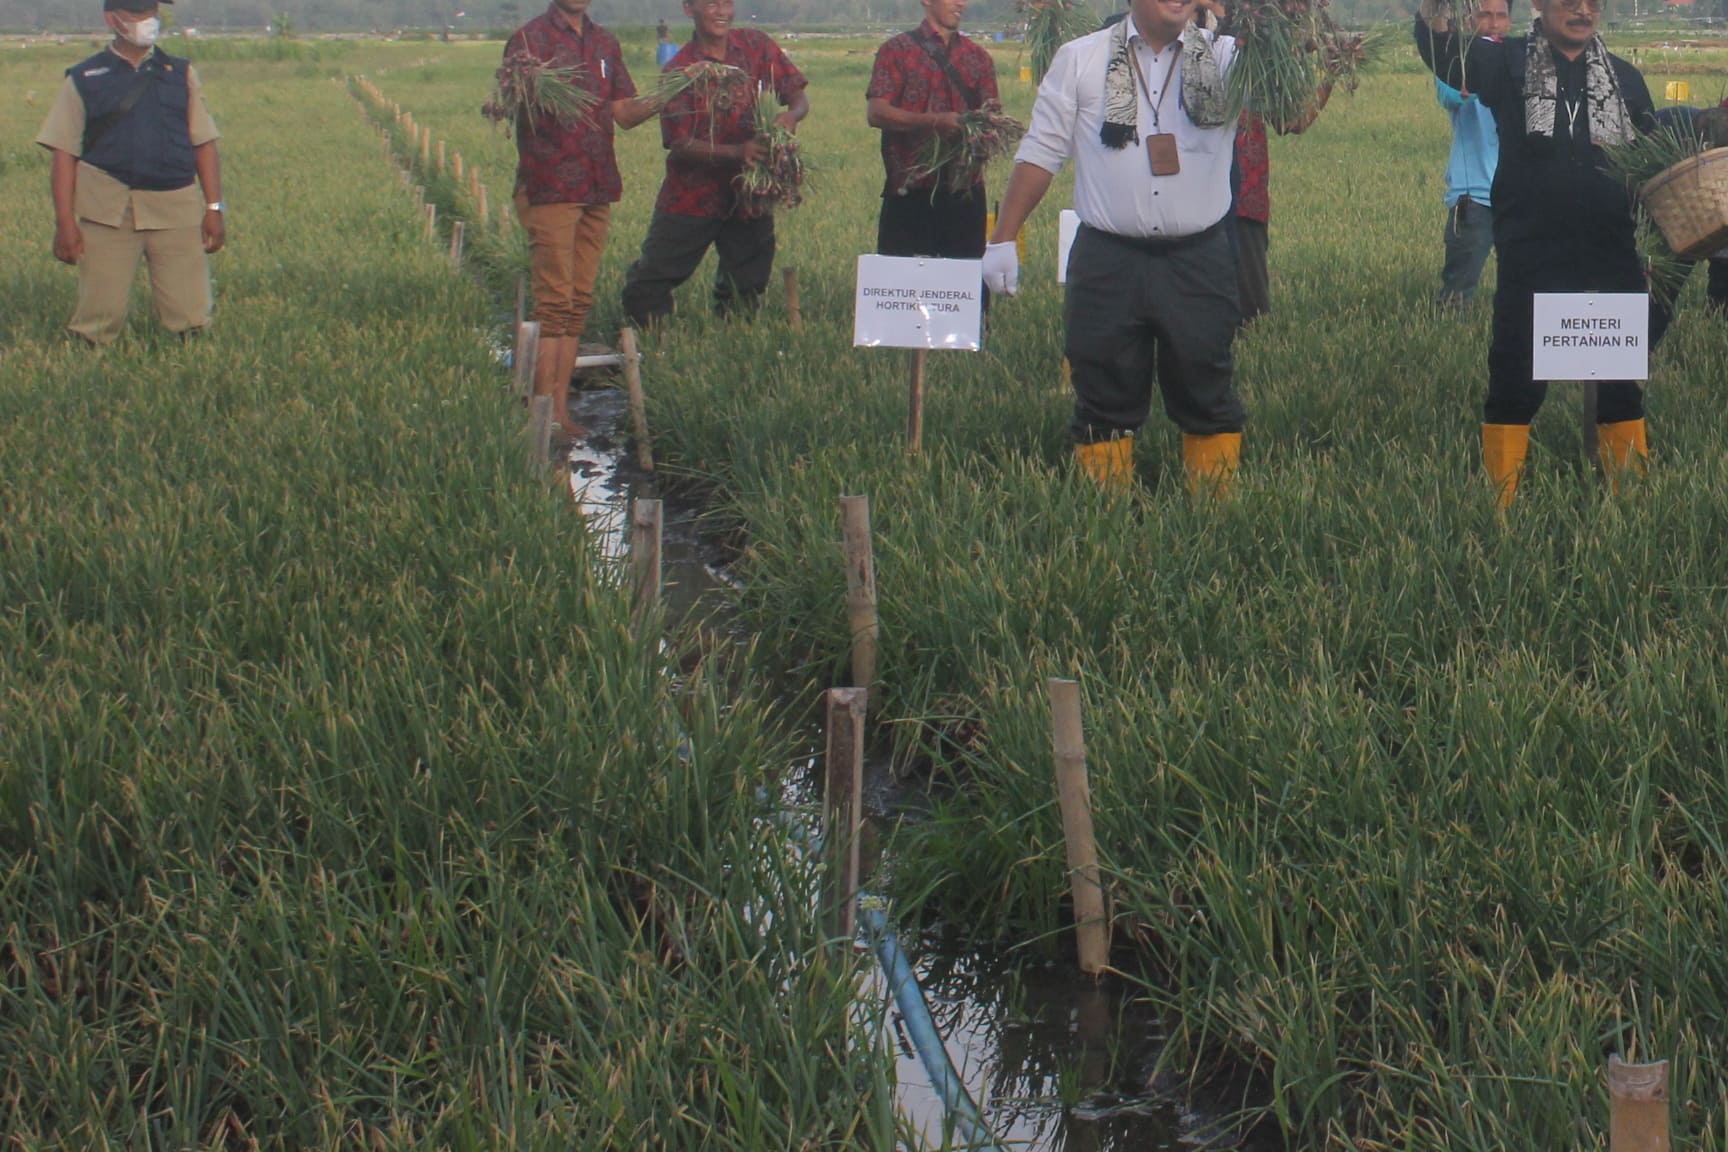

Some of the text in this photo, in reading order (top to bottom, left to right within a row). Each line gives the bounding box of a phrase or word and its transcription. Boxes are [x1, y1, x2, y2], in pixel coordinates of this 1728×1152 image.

[863, 288, 975, 300] DIREKTUR JENDERAL
[876, 301, 960, 313] HORTIKTURA
[1561, 318, 1621, 329] MENTERI
[1543, 336, 1638, 347] PERTANIAN RI
